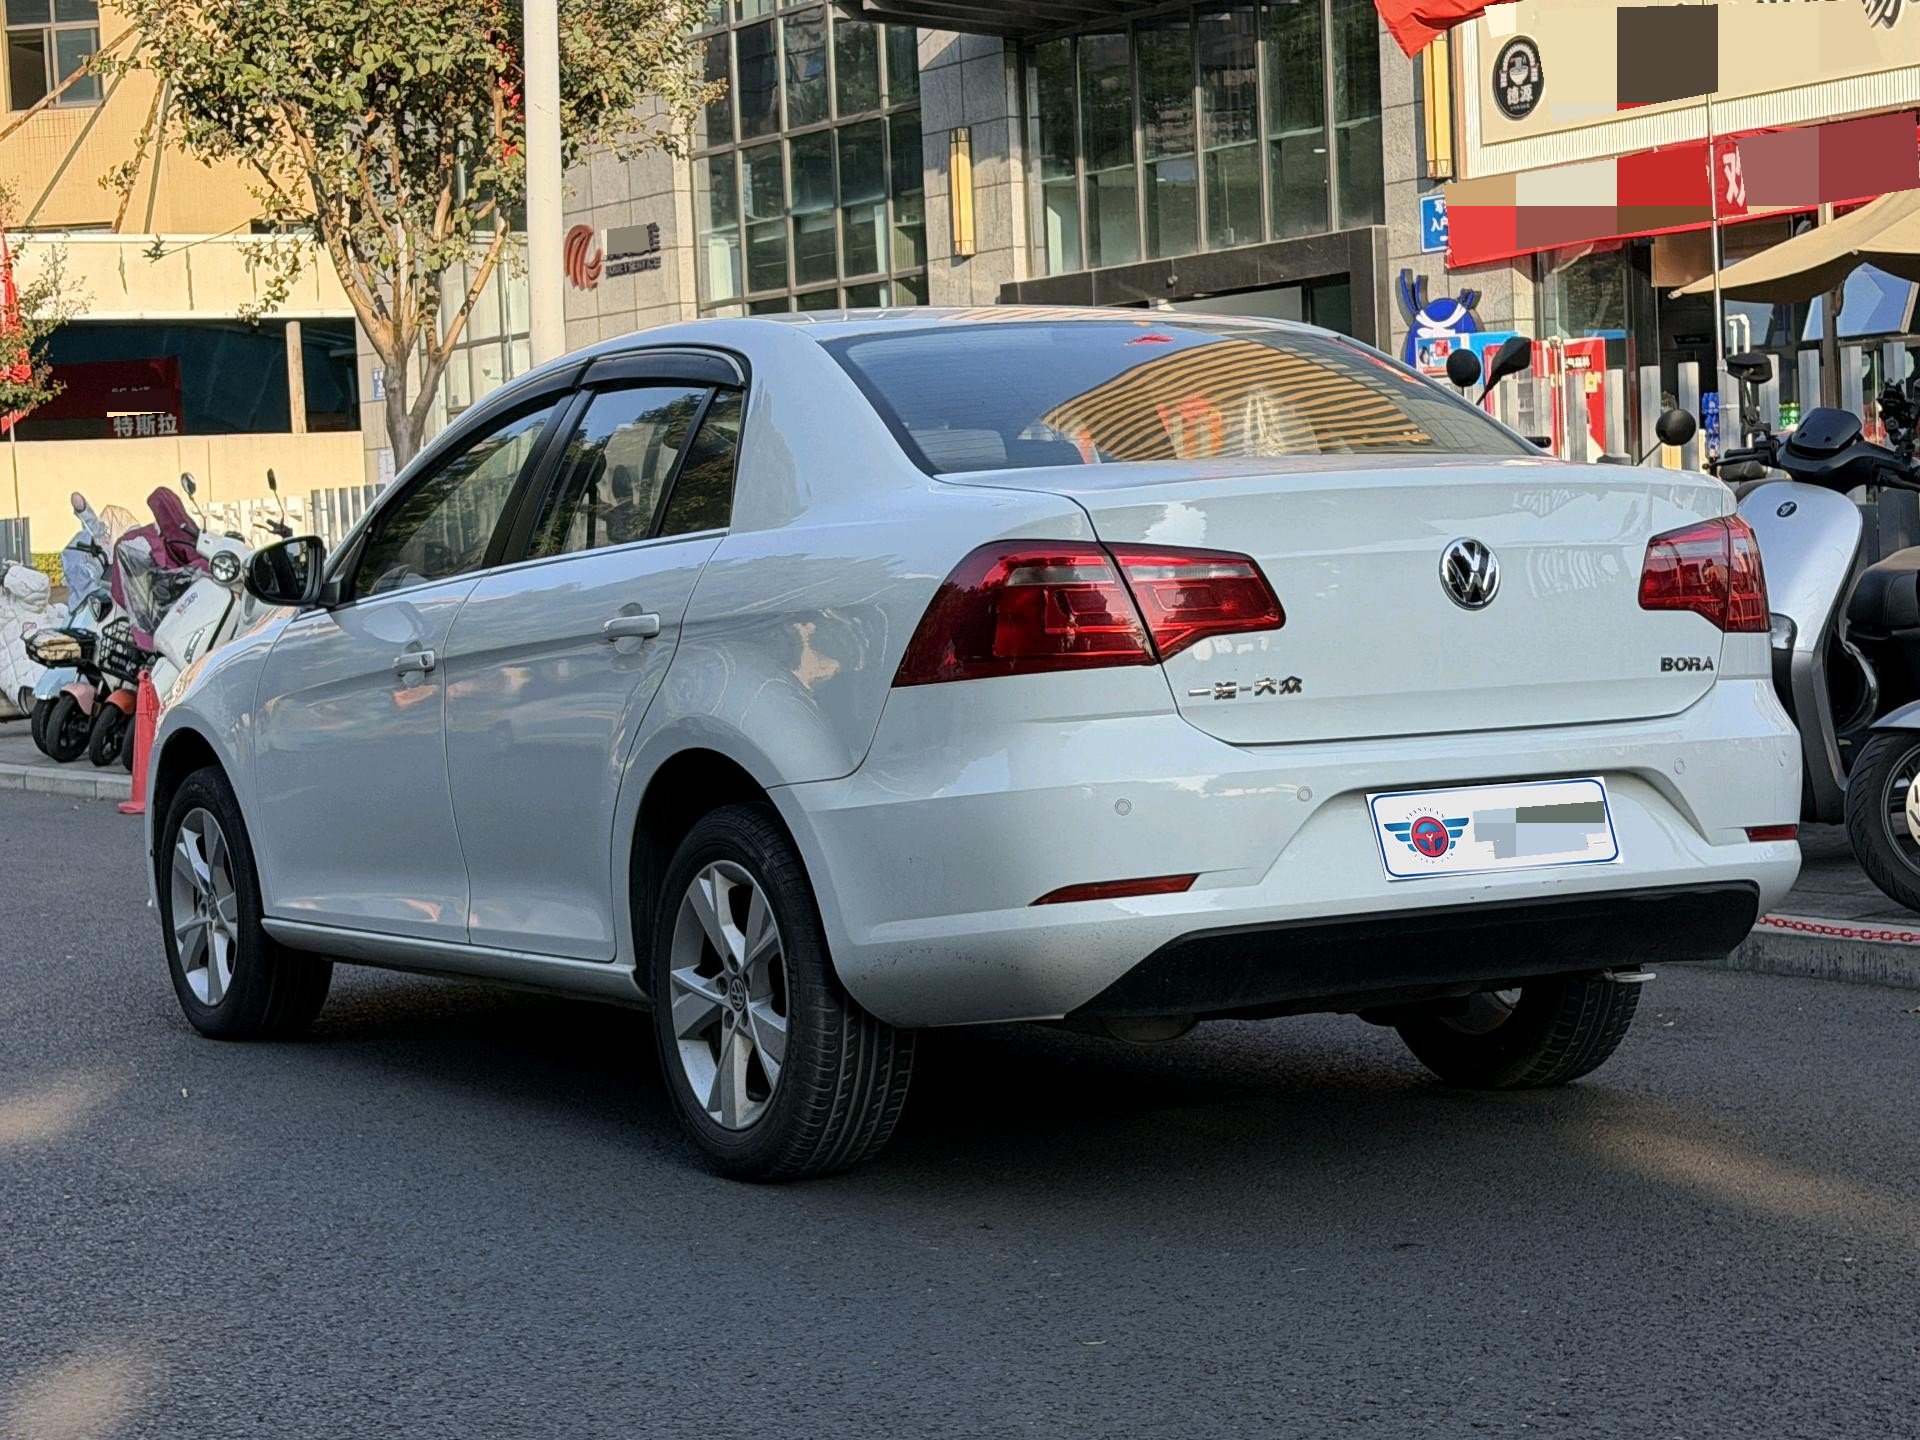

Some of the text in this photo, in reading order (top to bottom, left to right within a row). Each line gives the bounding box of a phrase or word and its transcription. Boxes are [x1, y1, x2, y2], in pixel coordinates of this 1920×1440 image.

[113, 412, 179, 438] 特斯拉
[1660, 655, 1715, 672] BORA
